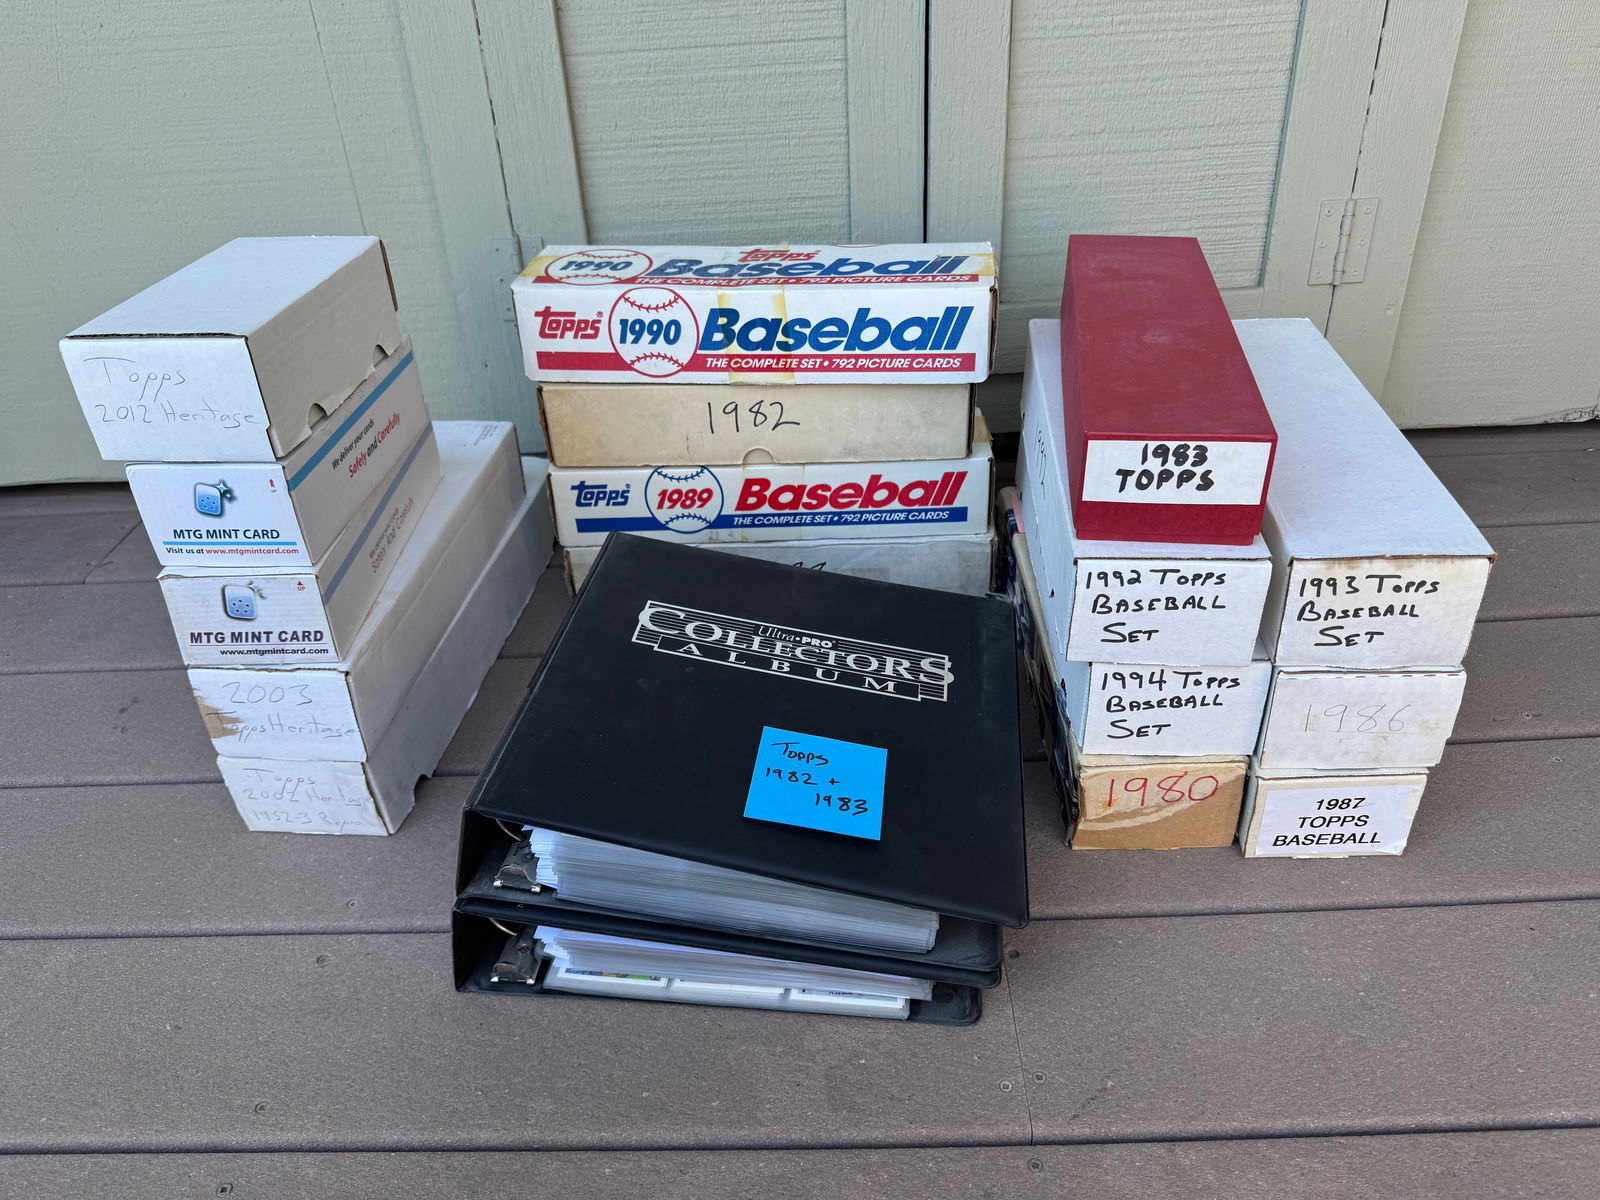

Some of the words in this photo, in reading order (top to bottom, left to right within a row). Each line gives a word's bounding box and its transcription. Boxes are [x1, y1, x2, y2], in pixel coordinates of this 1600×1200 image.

[560, 260, 632, 271] 1990
[645, 255, 970, 277] Baseball
[657, 278, 756, 286] COMPLETE
[799, 276, 831, 284] 792
[831, 275, 905, 283] PICTURE
[906, 274, 971, 282] CARDS
[619, 318, 682, 345] 1990
[698, 306, 974, 352] Baseball
[706, 358, 728, 368] THE
[729, 358, 798, 368] COMPLETE
[800, 358, 822, 368] SET
[831, 358, 855, 369] 792
[857, 358, 911, 368] PICTURE
[912, 357, 962, 368] CARDS
[95, 404, 153, 424] 2012
[706, 400, 800, 434] 1982
[348, 450, 367, 478] Safely
[366, 435, 379, 457] and
[377, 412, 400, 444] Carefully
[1141, 443, 1209, 467] 1983
[734, 471, 968, 512] Baseball
[1115, 468, 1215, 493] TOPPS
[656, 488, 714, 510] 1989
[733, 516, 753, 526] THE
[753, 515, 813, 526] COMPLETE
[813, 514, 834, 524] SET
[840, 513, 861, 523] 792
[861, 512, 908, 522] PICTURE
[908, 511, 950, 520] CARDS
[173, 529, 203, 540] MTG
[206, 529, 240, 540] MINT
[243, 529, 281, 540] CARD
[205, 547, 300, 556] www.mtgmintcard.com
[1086, 569, 1142, 589] 1992
[1299, 575, 1360, 597] 1993
[190, 632, 225, 643] MTG
[230, 631, 273, 643] MINT
[278, 630, 324, 642] CARD
[638, 607, 955, 685] COLLECTORS
[220, 647, 329, 656] www.mtgmintcard.com
[680, 642, 898, 694] ALBUM
[1101, 669, 1167, 691] 1994
[222, 682, 313, 706] 2003
[1304, 704, 1411, 733] 1986
[765, 767, 818, 786] 1982
[1107, 770, 1219, 807] 1980
[815, 793, 870, 815] 1983
[1315, 797, 1366, 811] 1987
[1297, 815, 1370, 829] TOPPS
[1272, 832, 1382, 847] BASEBALL
